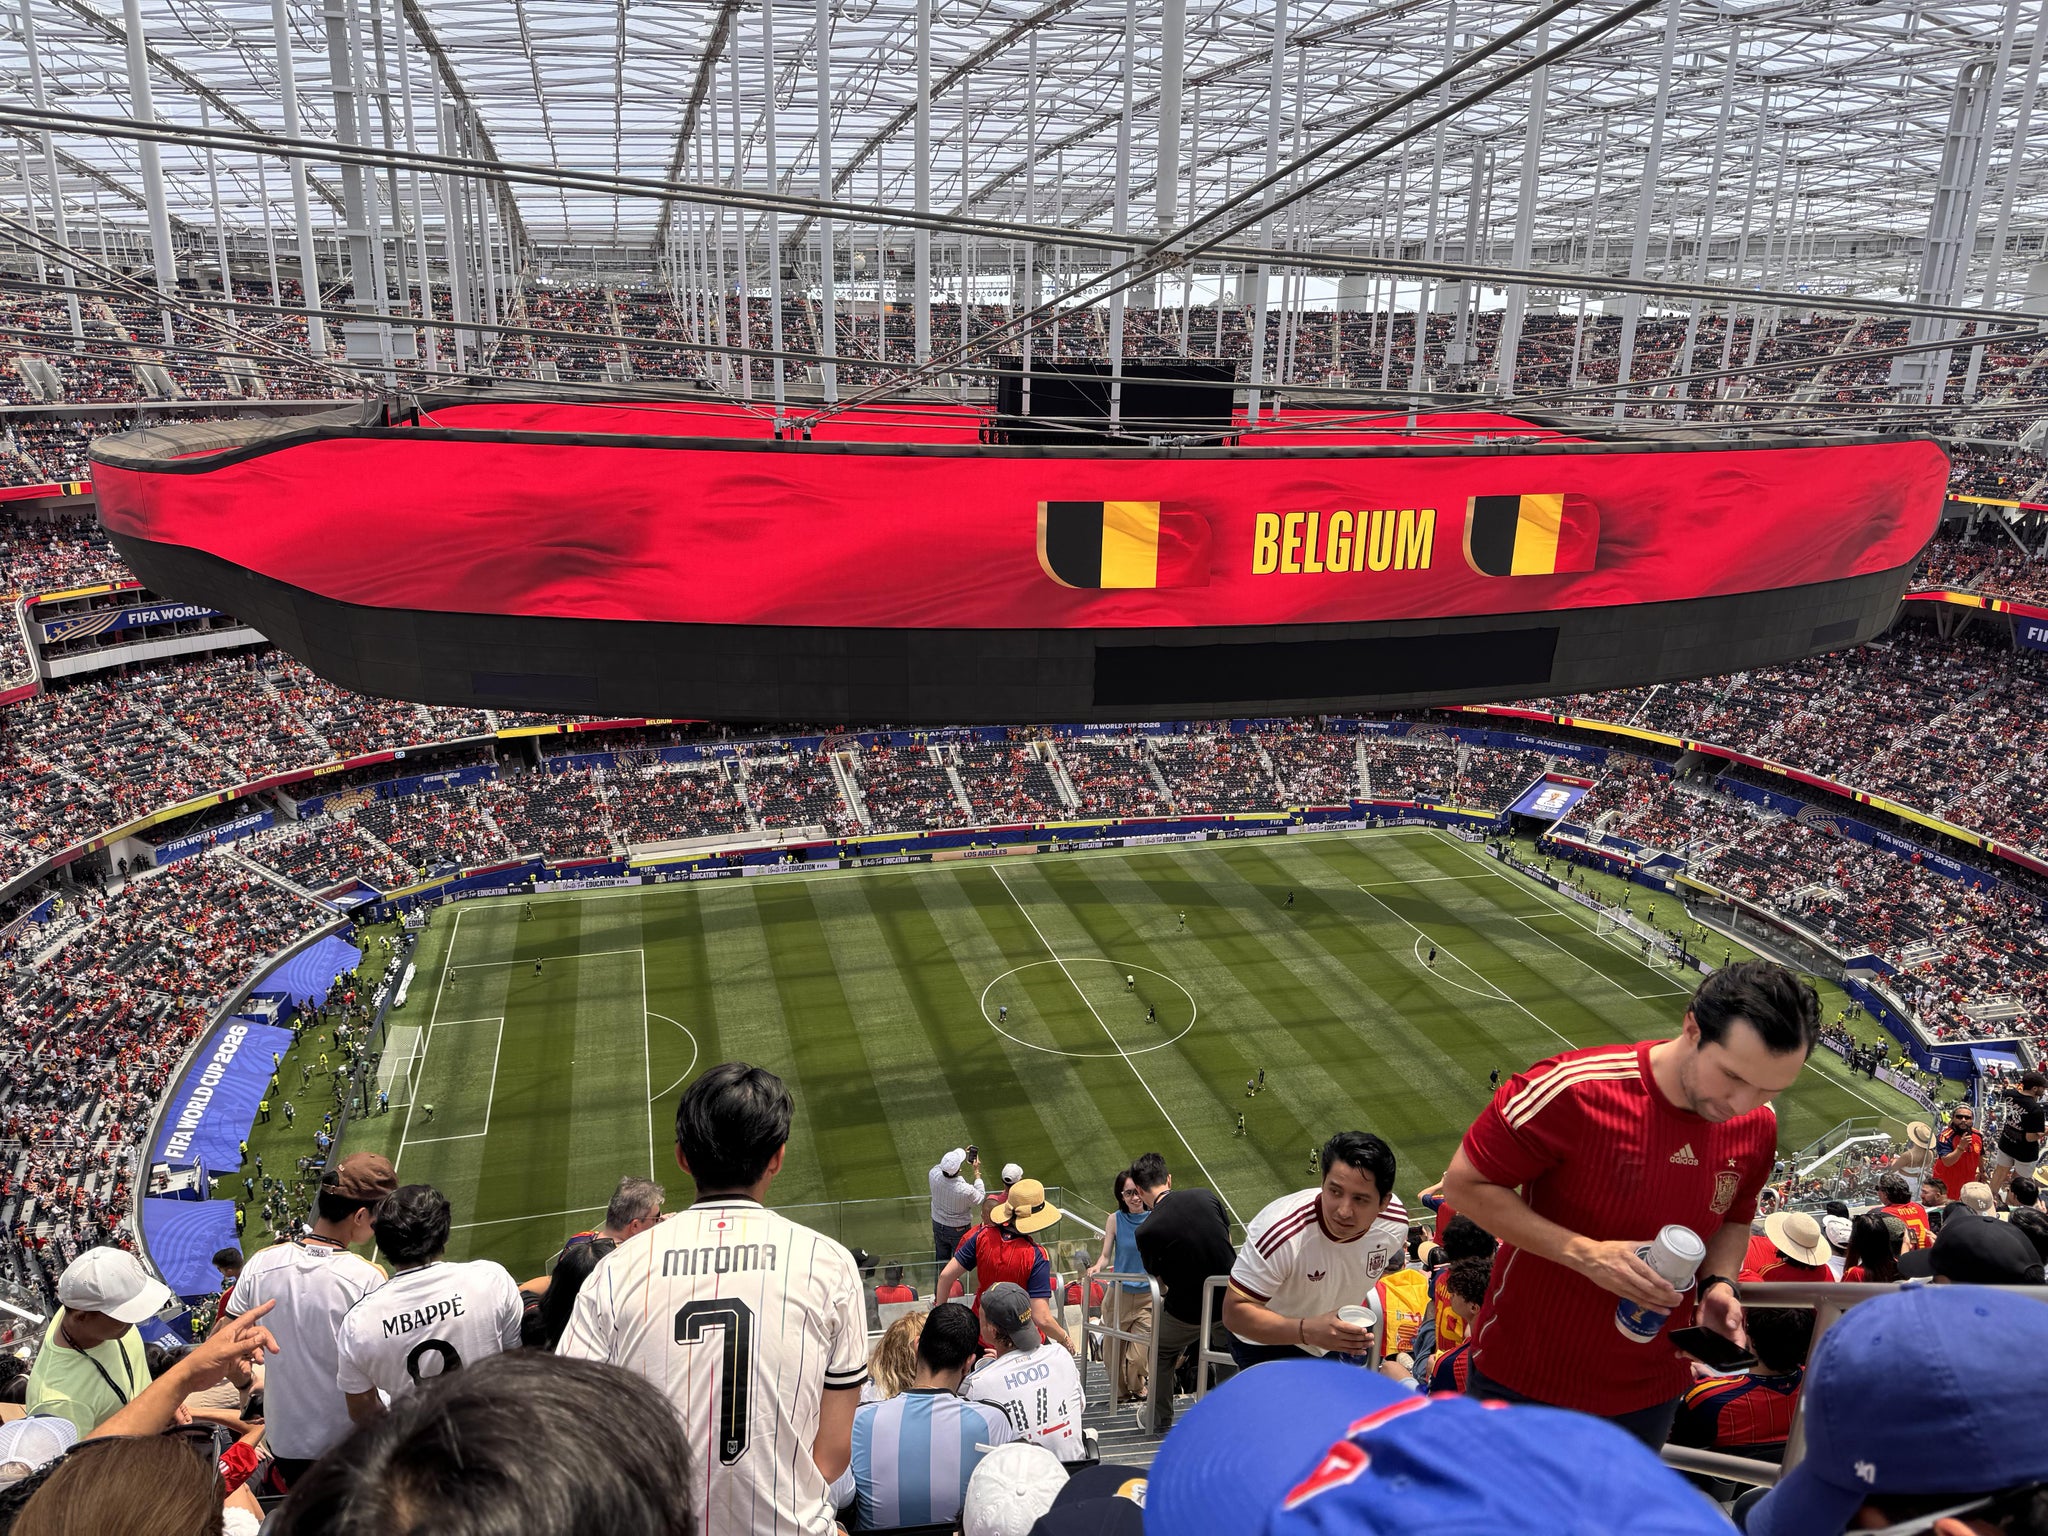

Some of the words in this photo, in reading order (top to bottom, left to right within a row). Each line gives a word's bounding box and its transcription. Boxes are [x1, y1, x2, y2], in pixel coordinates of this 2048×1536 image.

[1252, 508, 1437, 575] BELGIUM
[128, 610, 160, 625] FIFA
[162, 604, 212, 621] WORLD
[645, 718, 673, 726] BELGIUM
[1137, 721, 1161, 729] 2026
[1515, 735, 1534, 744] LOS
[1535, 738, 1581, 751] ANGELES
[313, 763, 345, 776] BELGIUM
[1762, 763, 1788, 776] BELGIUM
[1324, 822, 1347, 831] EDUCATION
[1402, 818, 1426, 826] EDUCATION
[168, 841, 187, 851] FIFA
[218, 824, 235, 834] CUP
[234, 814, 263, 829] 2026
[1245, 828, 1267, 837] EDUCATION
[1078, 840, 1103, 850] EDUCATION
[1876, 831, 1892, 844] FIFA
[1919, 848, 1934, 859] CUP
[1934, 855, 1961, 871] 2026
[979, 848, 1008, 857] ANGELES
[883, 855, 909, 865] EDUCATION
[788, 863, 816, 872] EDUCATION
[689, 871, 718, 880] EDUCATION
[585, 879, 616, 888] EDUCATION
[477, 887, 508, 897] EDUCATION
[213, 1024, 249, 1064] 2026
[200, 1062, 226, 1087] CUP
[176, 1086, 214, 1129] WORLD
[163, 1129, 195, 1159] FIFA
[1669, 1155, 1699, 1166] adidas
[662, 1243, 777, 1277] MITOMA
[382, 1293, 466, 1339] MBAPPÉ
[674, 1297, 755, 1466] 7
[1003, 1363, 1050, 1390] HOOD
